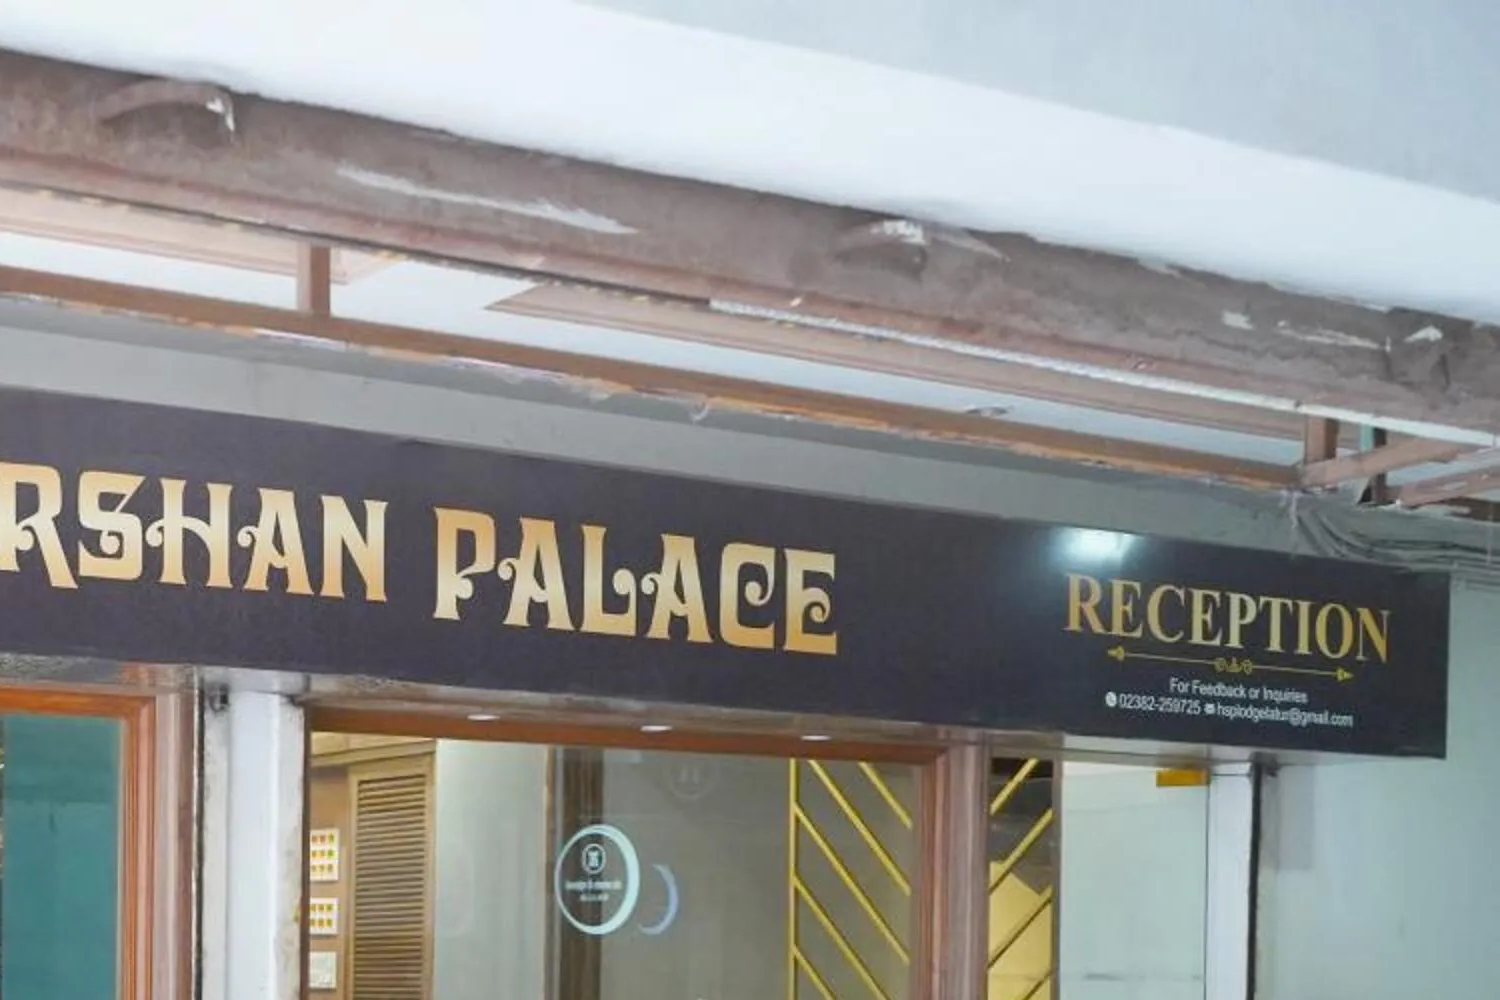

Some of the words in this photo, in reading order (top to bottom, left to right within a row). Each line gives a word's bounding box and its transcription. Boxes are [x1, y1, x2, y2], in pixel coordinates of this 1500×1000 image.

[433, 507, 840, 656] PALACE
[1063, 573, 1391, 664] RECEPTION
[1169, 677, 1190, 694] For
[1191, 679, 1246, 699] Feedback
[1248, 687, 1260, 699] or
[1263, 686, 1308, 705] Inquiries
